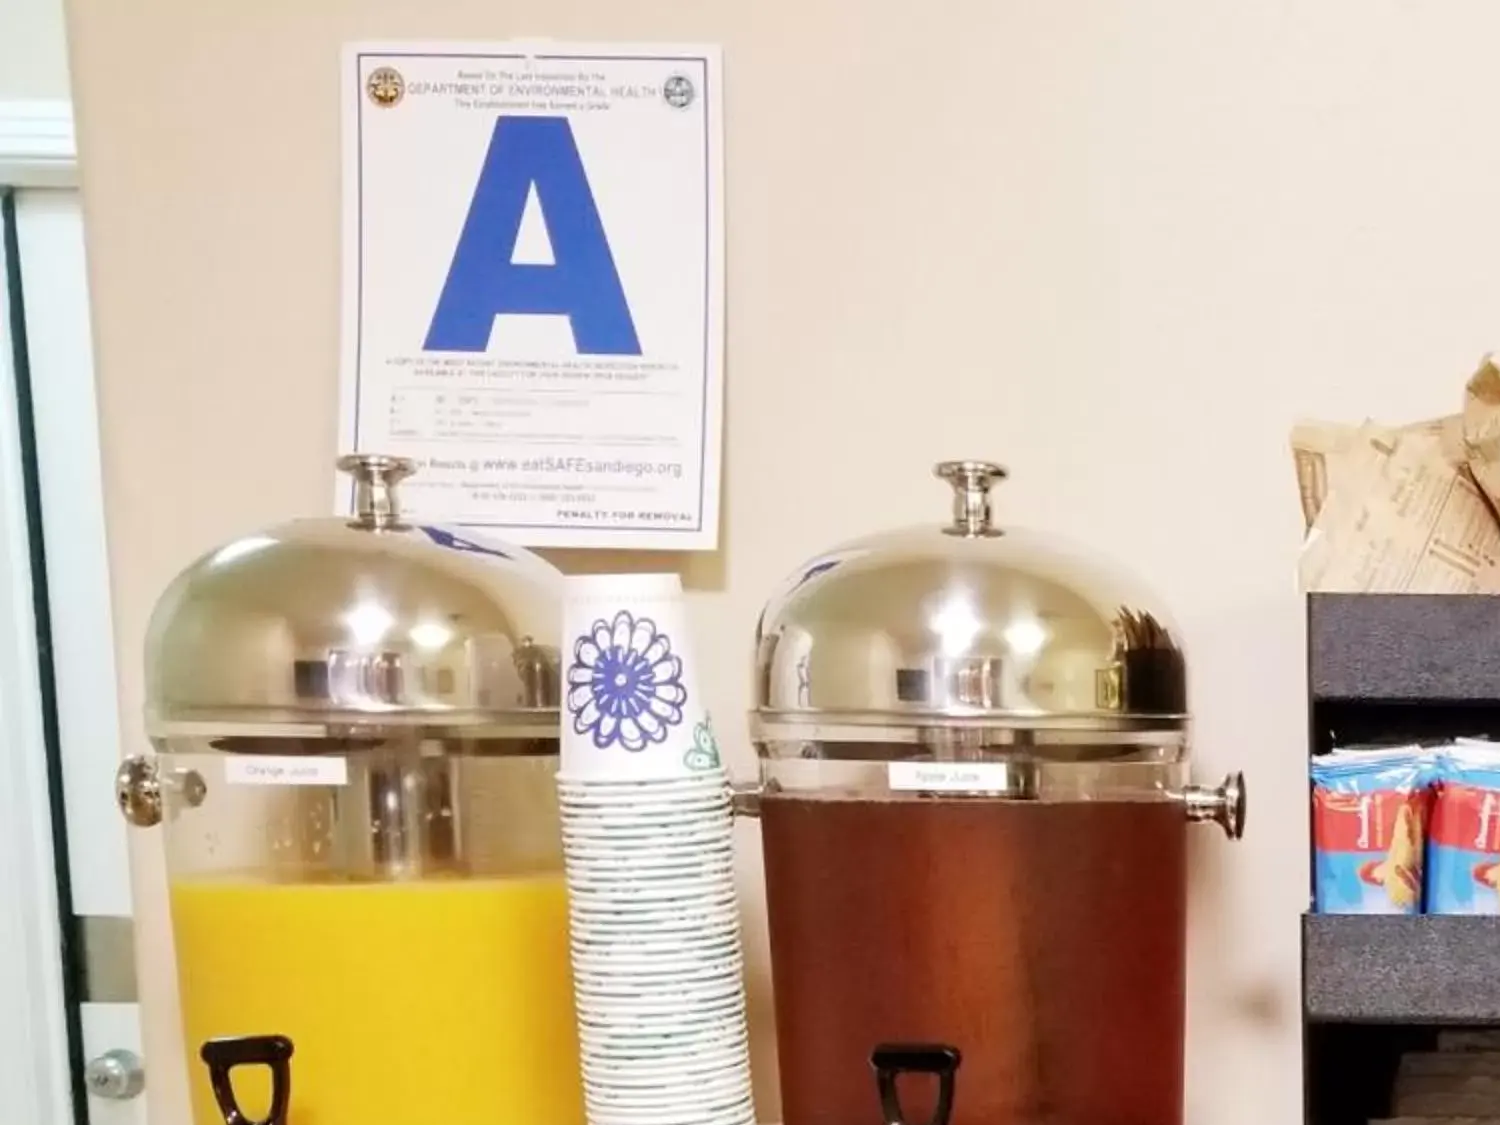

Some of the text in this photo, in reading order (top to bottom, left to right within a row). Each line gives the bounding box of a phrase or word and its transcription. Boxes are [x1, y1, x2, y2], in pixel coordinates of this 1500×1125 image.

[407, 82, 657, 98] DEPARTMENT OF ENVIRONMENTAL HEALTH
[422, 115, 643, 355] A
[557, 509, 693, 522] PENALTY FOR REMOVAL
